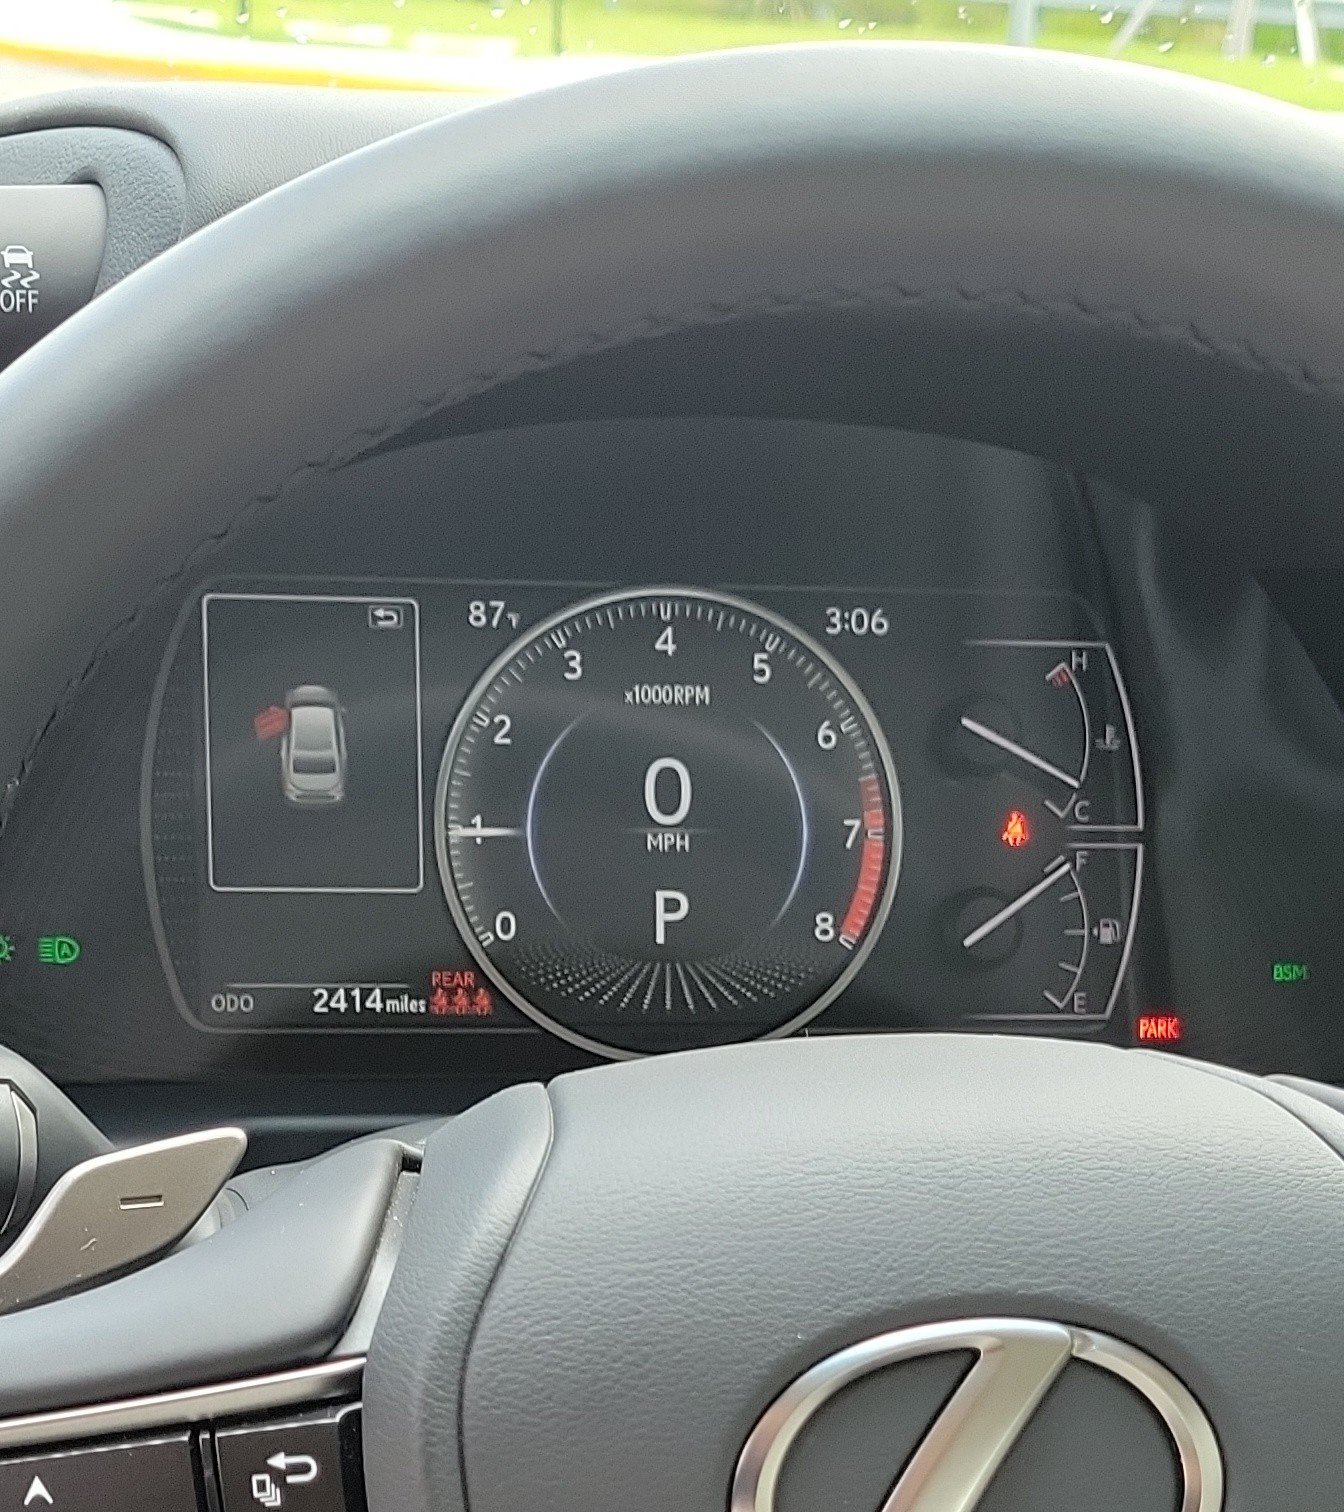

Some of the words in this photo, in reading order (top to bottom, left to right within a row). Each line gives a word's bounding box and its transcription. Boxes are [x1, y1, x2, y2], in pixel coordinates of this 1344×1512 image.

[0, 289, 39, 314] OFF
[825, 607, 890, 636] 3:06
[655, 626, 677, 656] 4
[563, 650, 583, 681] 3
[753, 653, 772, 684] 5
[1071, 650, 1088, 672] H
[493, 715, 512, 745] 2
[816, 721, 837, 750] 6
[644, 757, 692, 827] 0
[1074, 800, 1090, 823] C
[646, 833, 690, 853] MPH
[843, 820, 863, 850] 7
[495, 911, 516, 941] 0
[655, 890, 689, 945] P
[814, 912, 835, 942] 8
[432, 971, 476, 987] REAR
[210, 993, 254, 1014] ODO
[312, 988, 384, 1015] 2414
[385, 995, 427, 1015] miles
[1073, 992, 1088, 1013] E
[1138, 1016, 1180, 1040] PARK
